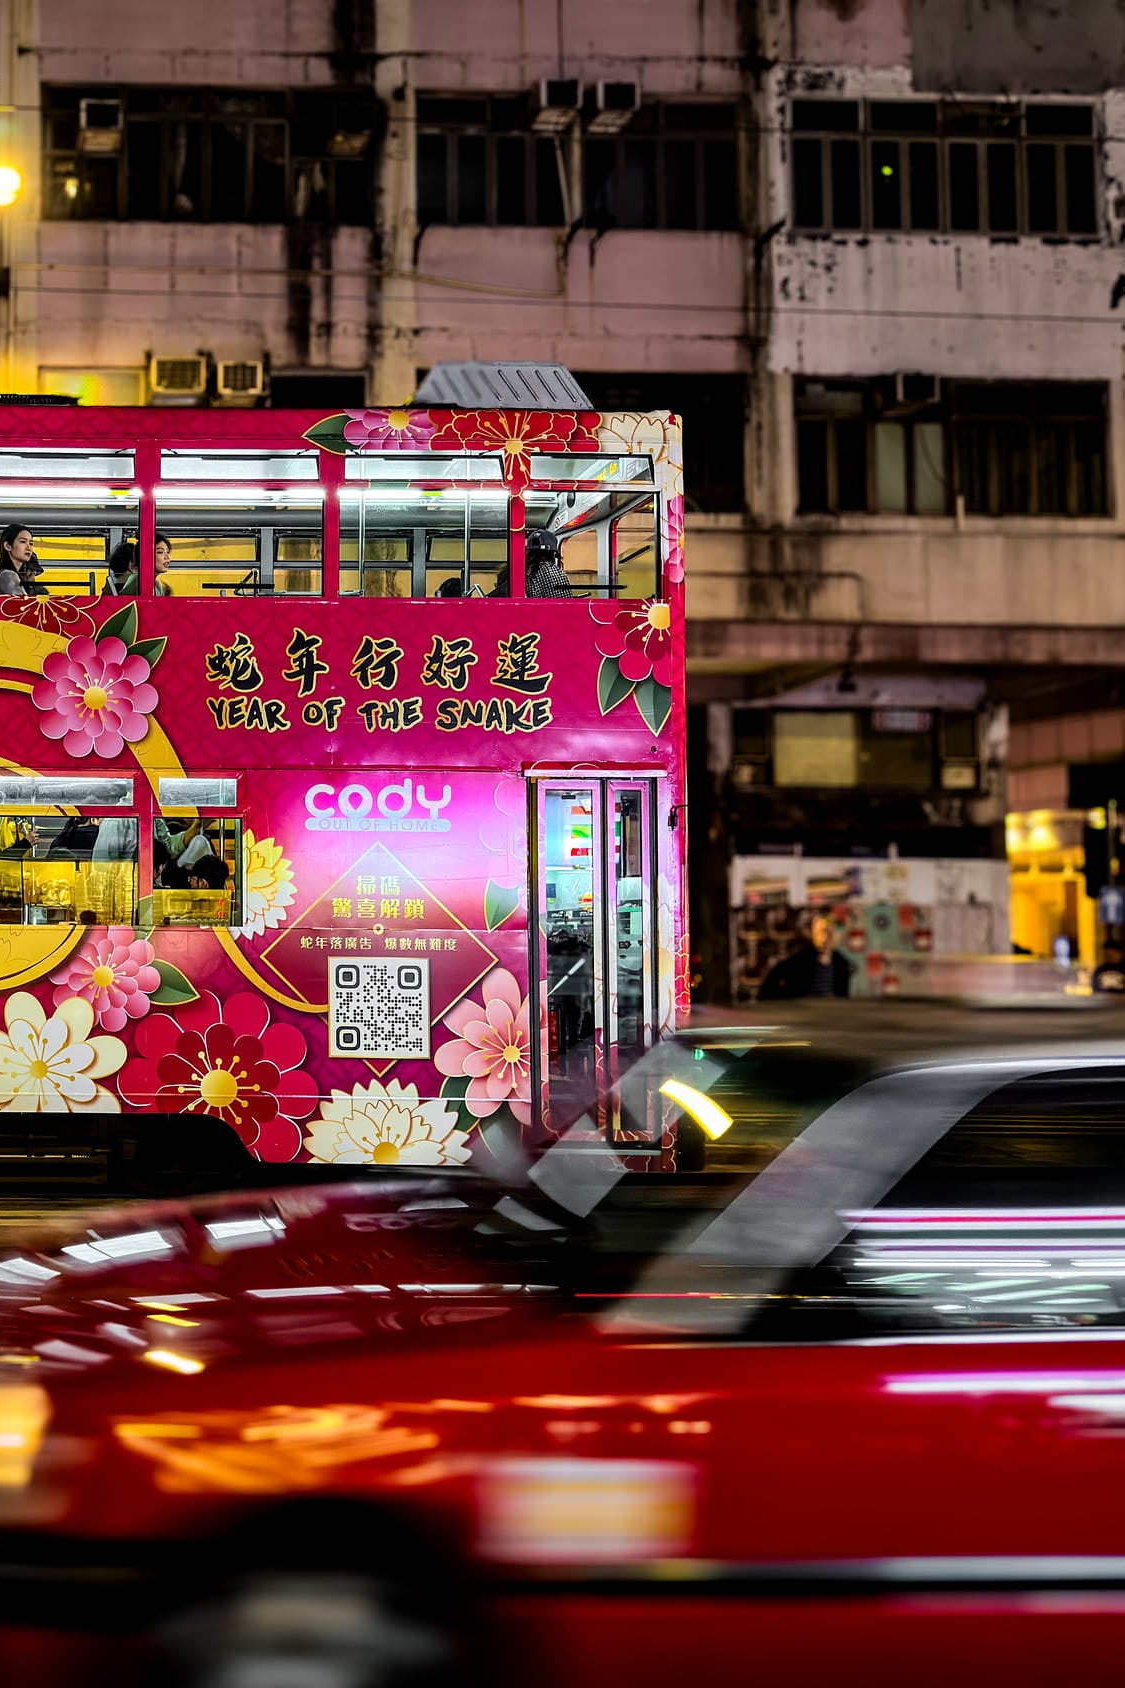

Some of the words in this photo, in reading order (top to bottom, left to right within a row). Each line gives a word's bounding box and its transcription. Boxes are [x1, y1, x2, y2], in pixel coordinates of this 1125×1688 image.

[206, 627, 553, 697] 蛇年行好運
[206, 697, 290, 731] YEAR
[303, 697, 345, 731] OF
[358, 697, 423, 732] THE
[436, 697, 553, 734] SNAKE
[319, 818, 350, 830] OUT
[359, 819, 381, 831] OF
[389, 819, 438, 832] HOME
[356, 875, 400, 896] 掃碼
[332, 897, 424, 919] 驚喜解鎖
[300, 936, 372, 950] 蛇年落廣告
